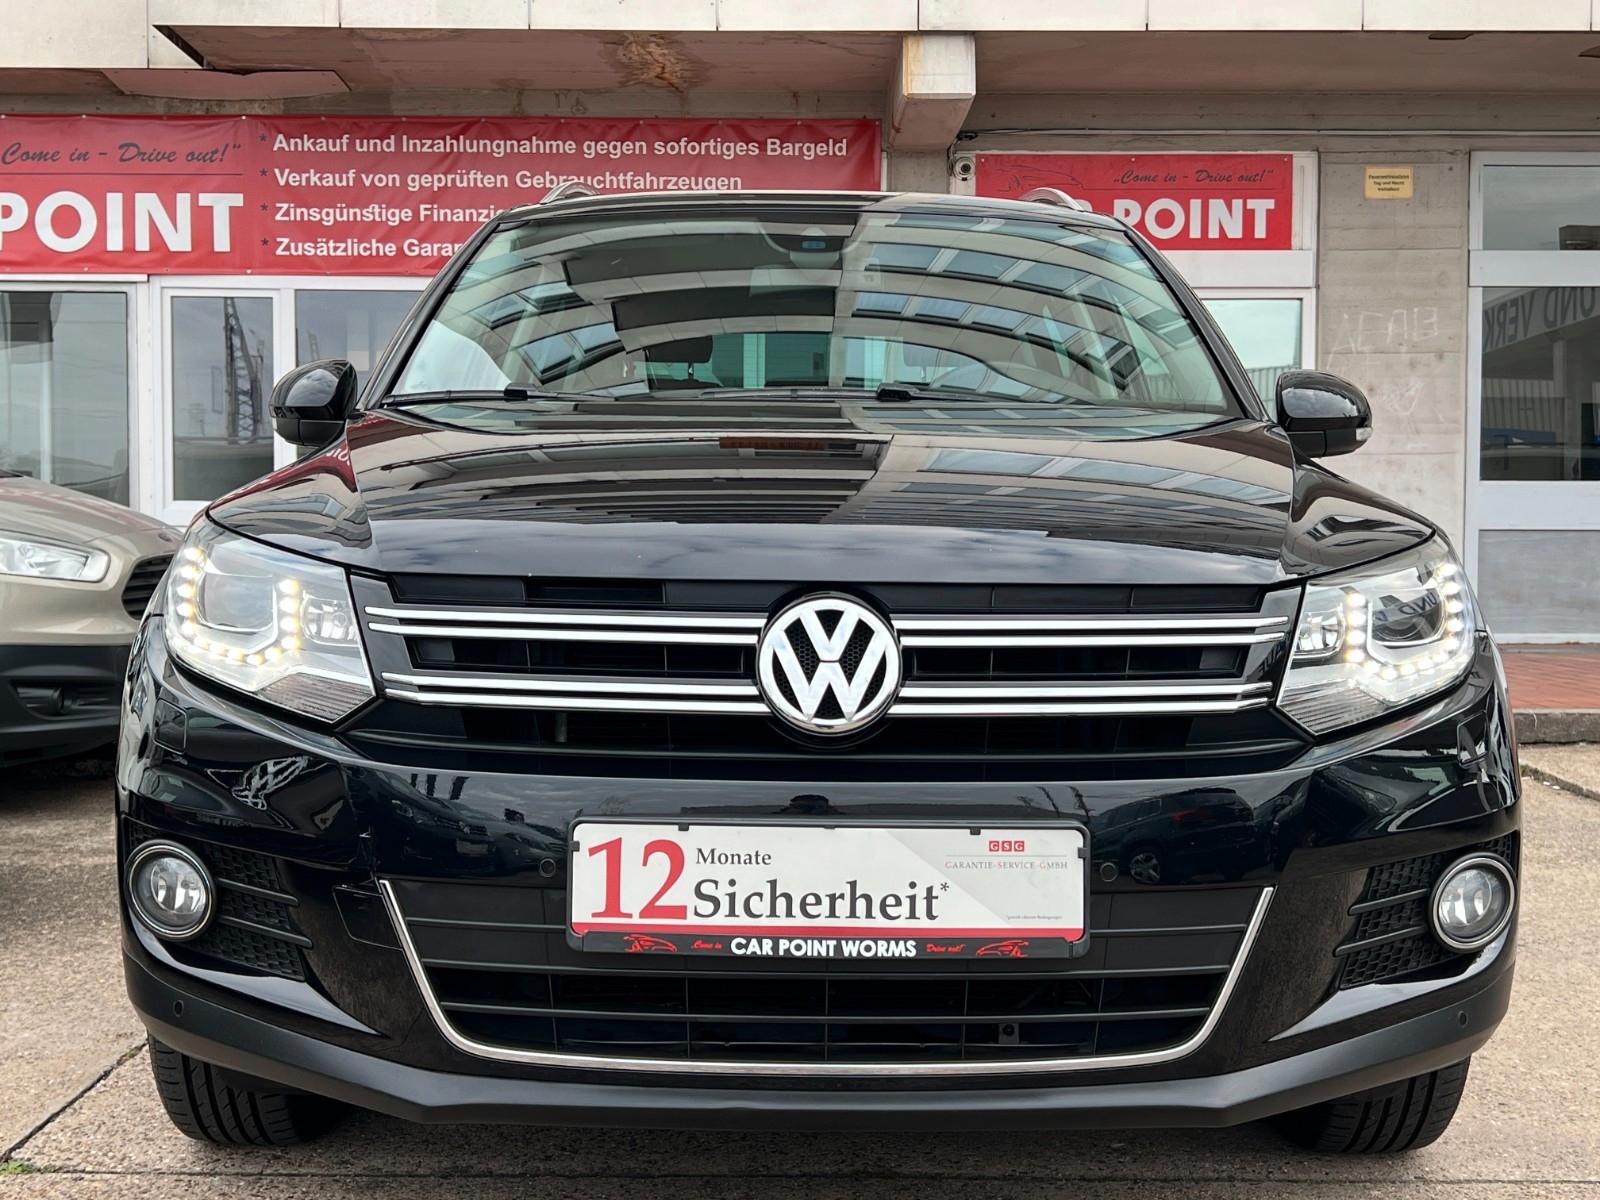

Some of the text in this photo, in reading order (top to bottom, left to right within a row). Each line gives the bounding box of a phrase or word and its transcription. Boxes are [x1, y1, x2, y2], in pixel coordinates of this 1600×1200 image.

[1, 142, 61, 165] Come
[69, 148, 90, 162] in
[118, 142, 177, 163] Drive
[273, 133, 847, 160] Ankauf und Inzahlungnahme gegen sofortiges Bargeld
[274, 168, 356, 187] Verkauf
[361, 174, 400, 187] von
[407, 170, 509, 191] geprüften
[1163, 172, 1177, 182] in
[1195, 169, 1233, 183] Drive
[0, 190, 244, 253] POINT
[274, 203, 413, 226] Zinsgünstige
[1113, 198, 1276, 240] POINT
[275, 237, 397, 256] Zusätzliche
[762, 597, 898, 727] VW
[696, 847, 772, 866] Monate
[988, 841, 1024, 852] GSG
[587, 837, 689, 920] 12
[730, 937, 917, 958] CAR POINT WORMS
